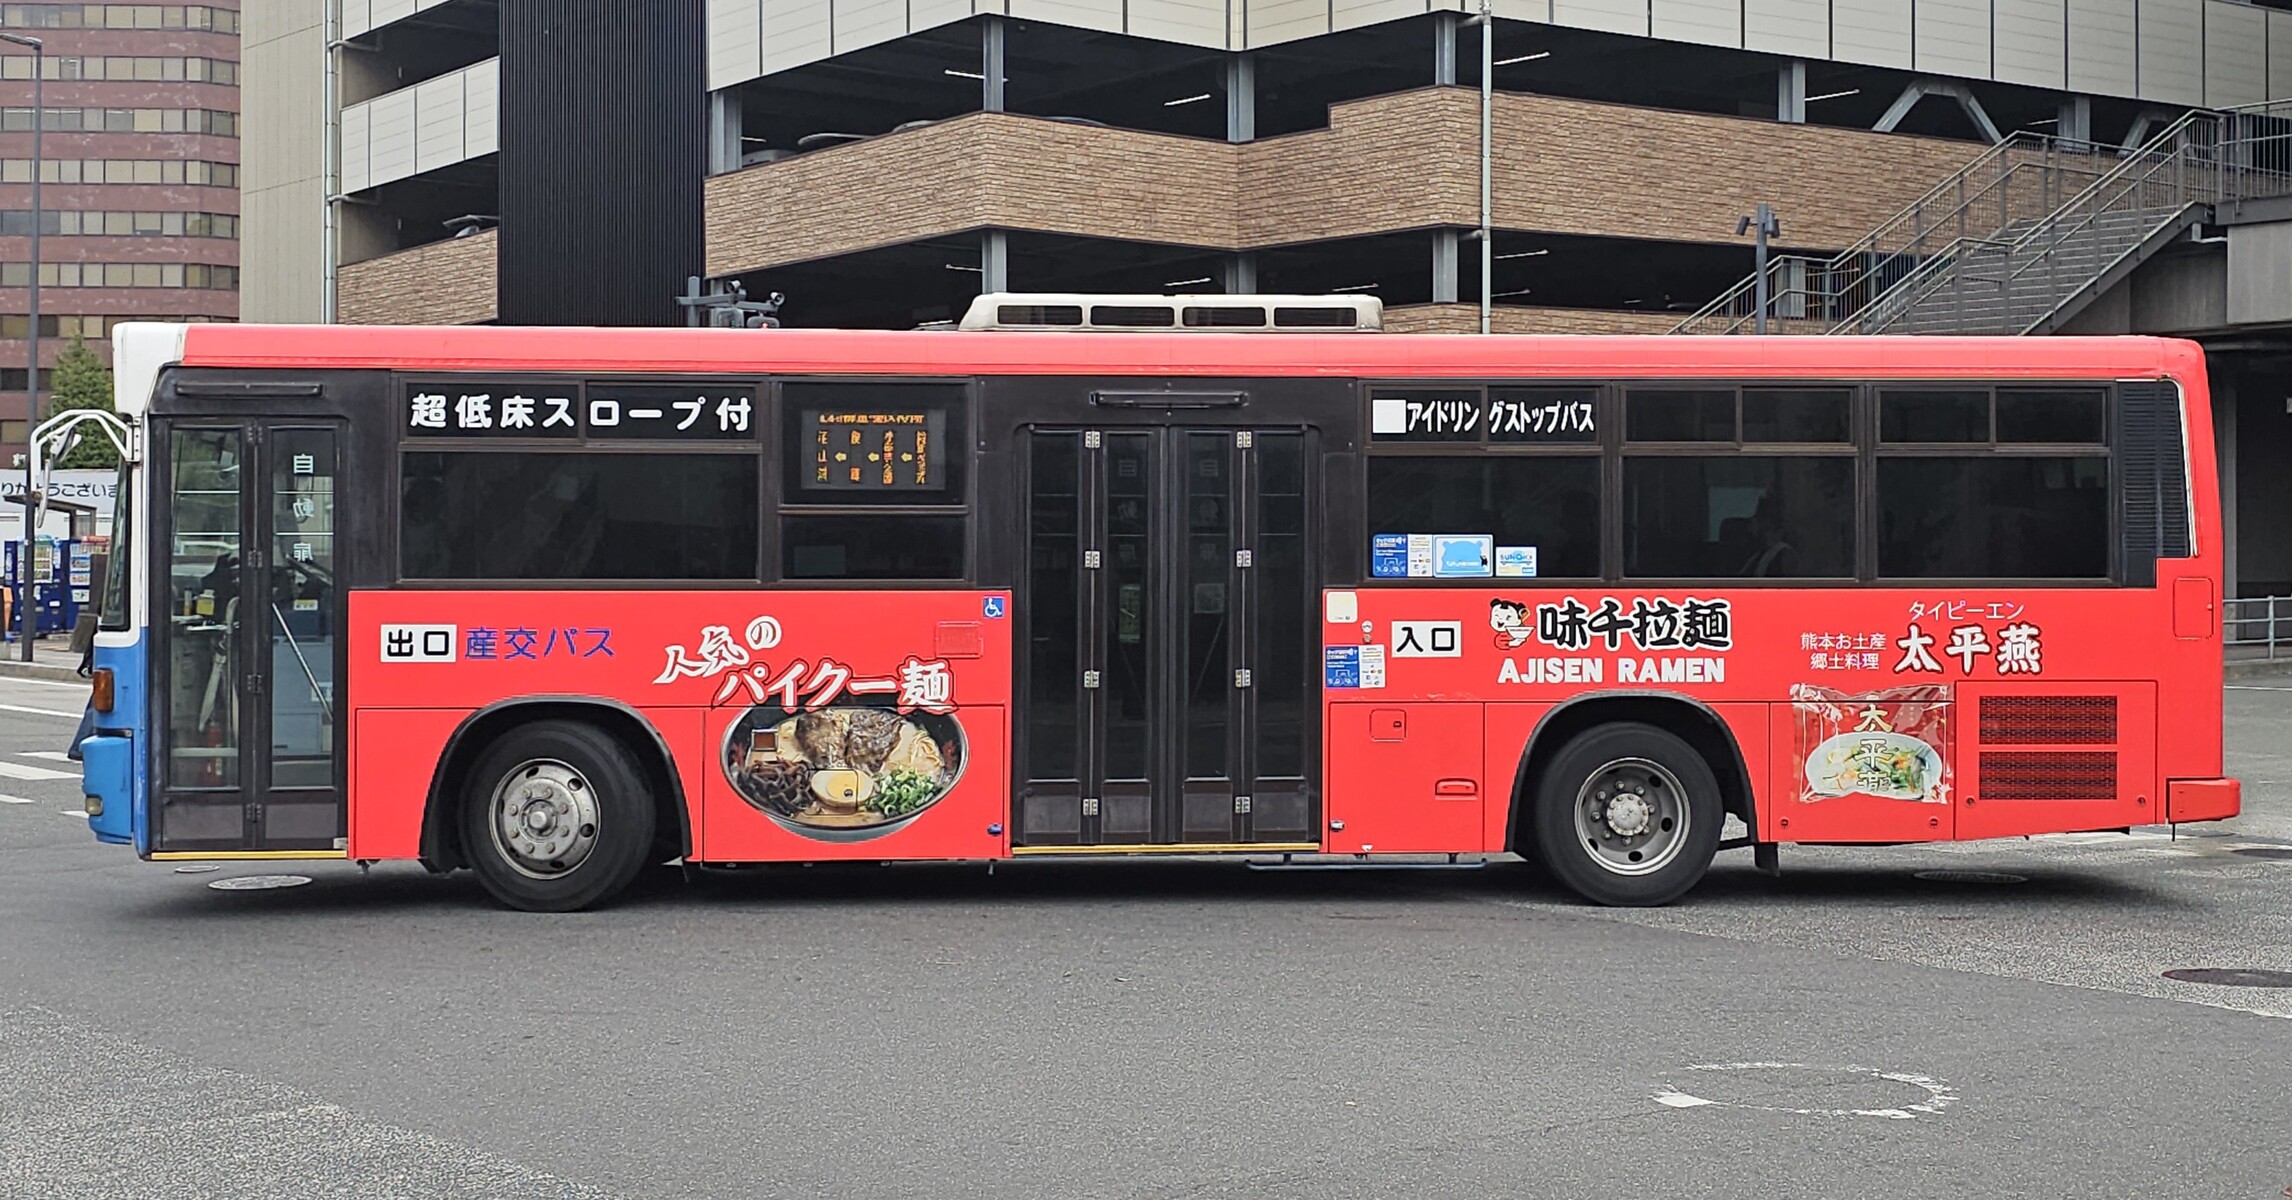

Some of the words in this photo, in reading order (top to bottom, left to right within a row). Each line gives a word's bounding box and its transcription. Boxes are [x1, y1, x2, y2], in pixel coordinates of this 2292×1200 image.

[410, 393, 752, 431] 超低床スロープ付
[1407, 401, 1594, 433] アイドリングストップバス
[1537, 598, 1731, 649] 味千拉麺
[1909, 600, 2024, 621] タイピーエン
[387, 629, 450, 657] 出口
[653, 615, 781, 684] 人気の
[1396, 625, 1456, 653] 入口
[1800, 633, 1887, 651] 熊本お土産
[1893, 623, 2043, 675] 太平燕
[1497, 657, 1602, 683] AJISEN
[1617, 657, 1725, 683] RAMEN
[1810, 652, 1880, 670] 郷土料理
[715, 658, 953, 711] パイクー麺
